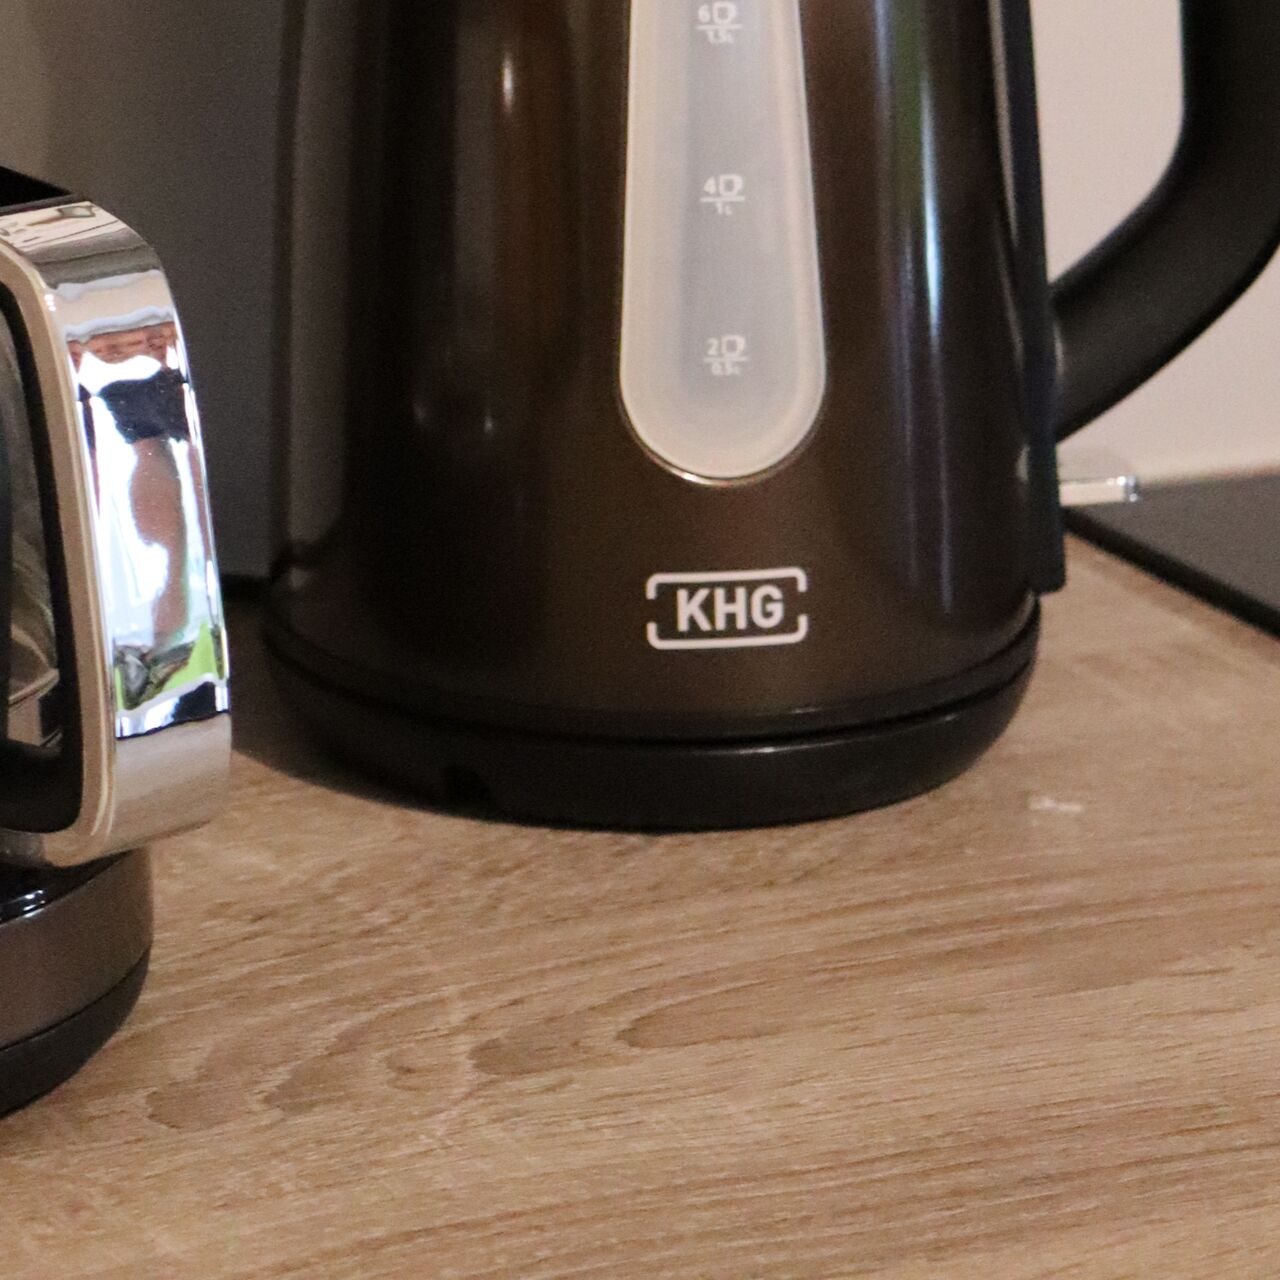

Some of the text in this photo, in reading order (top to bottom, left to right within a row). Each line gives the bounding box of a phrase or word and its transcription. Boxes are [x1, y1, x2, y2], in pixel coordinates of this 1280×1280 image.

[698, 3, 711, 24] 6
[703, 176, 717, 195] 4
[706, 337, 719, 356] 2
[676, 584, 785, 633] KHG
